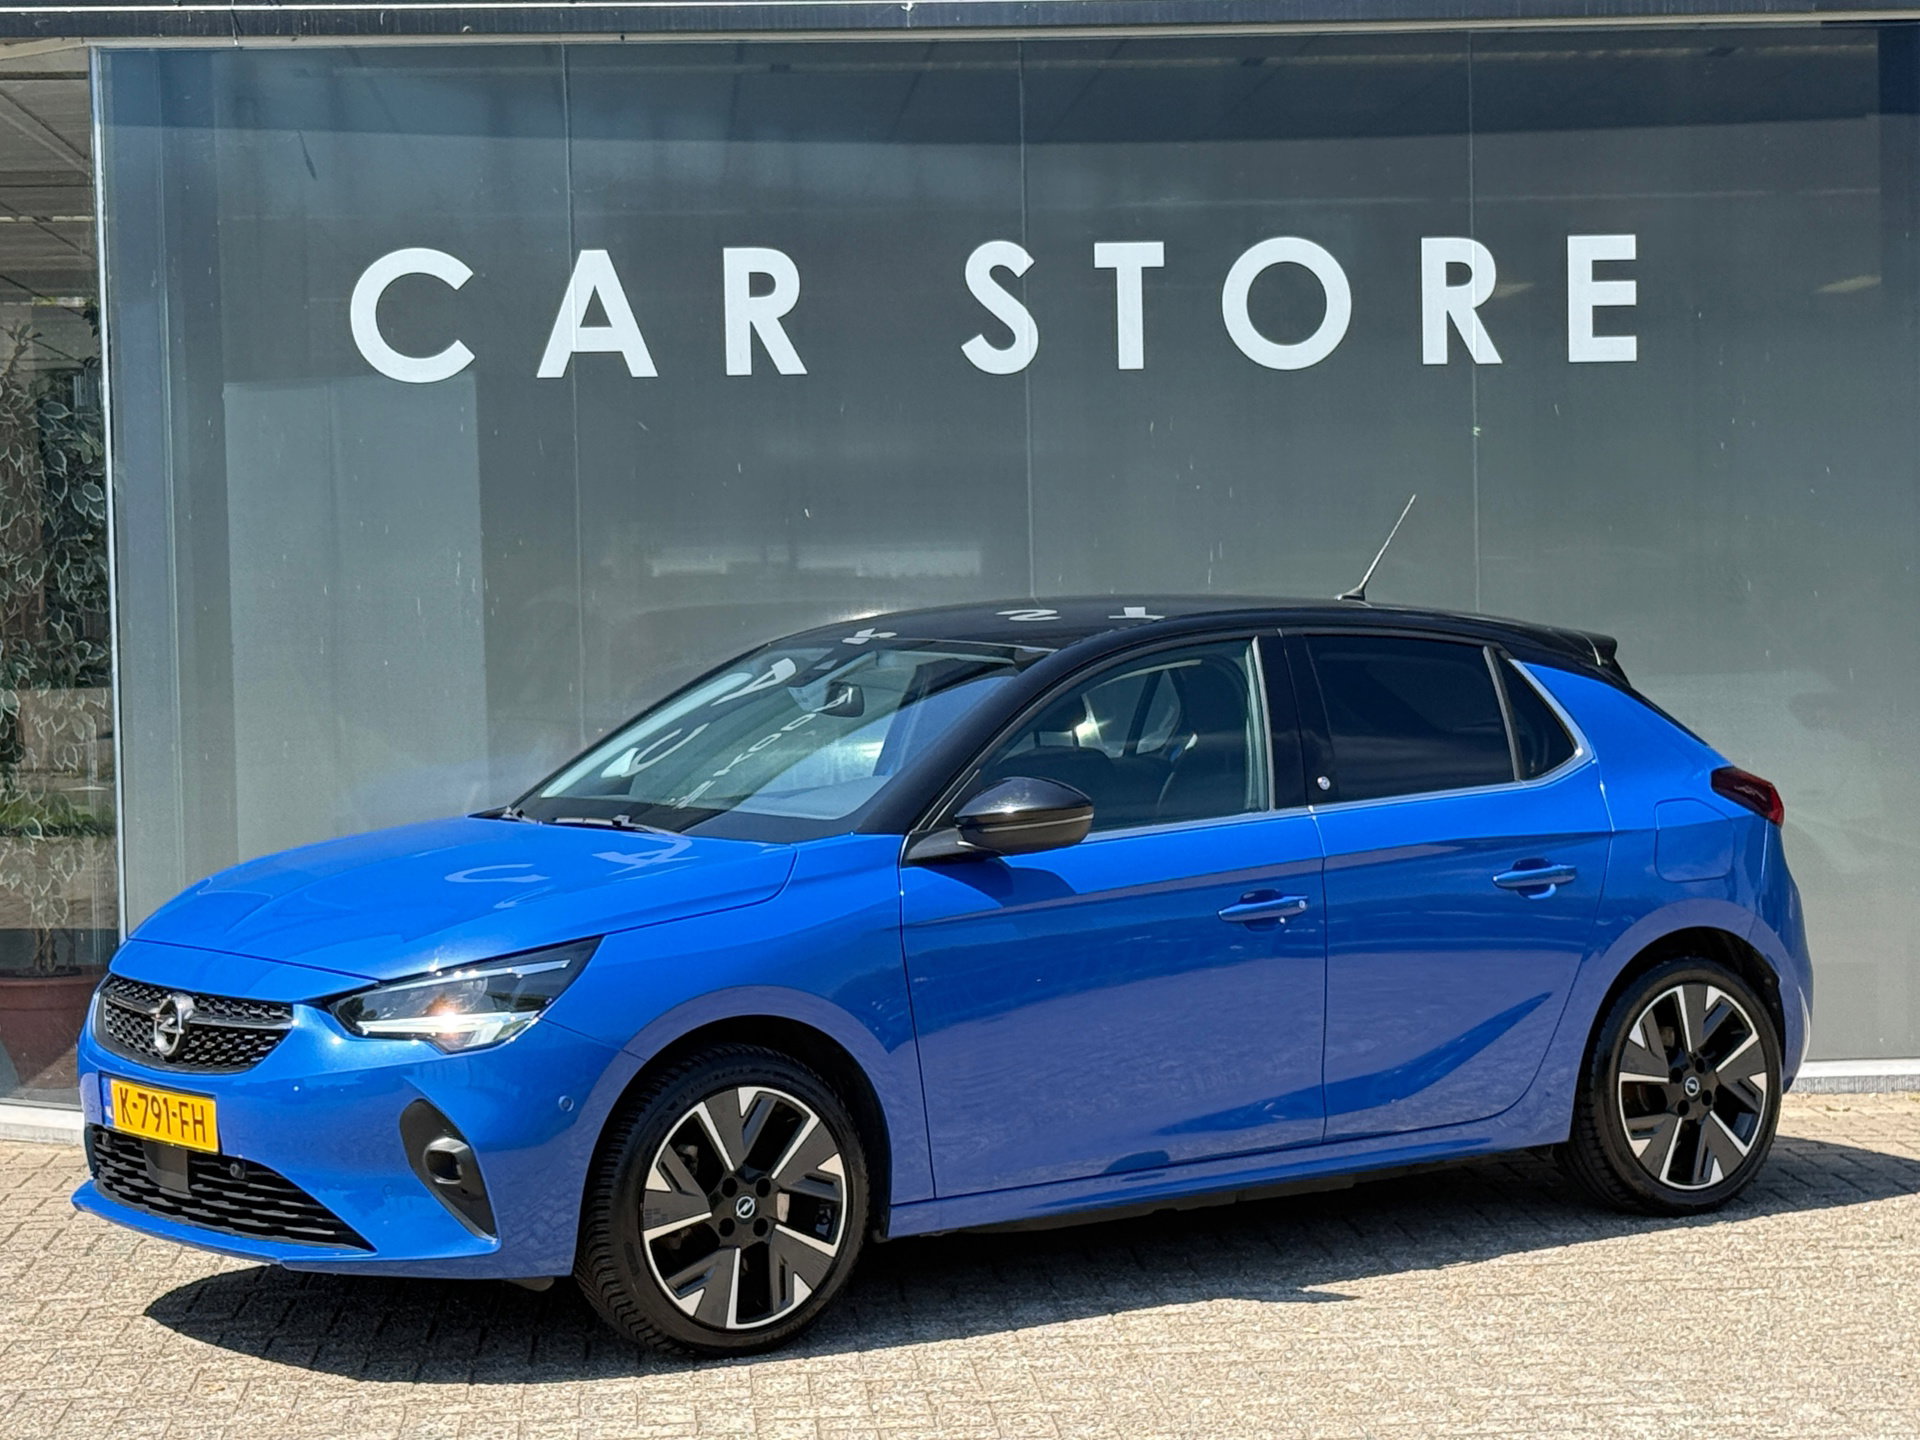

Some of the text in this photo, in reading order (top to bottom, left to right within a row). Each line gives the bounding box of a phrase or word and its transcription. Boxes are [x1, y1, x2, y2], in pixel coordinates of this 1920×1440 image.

[350, 234, 1638, 383] CAR STORE
[119, 1087, 206, 1143] K-791-FH
